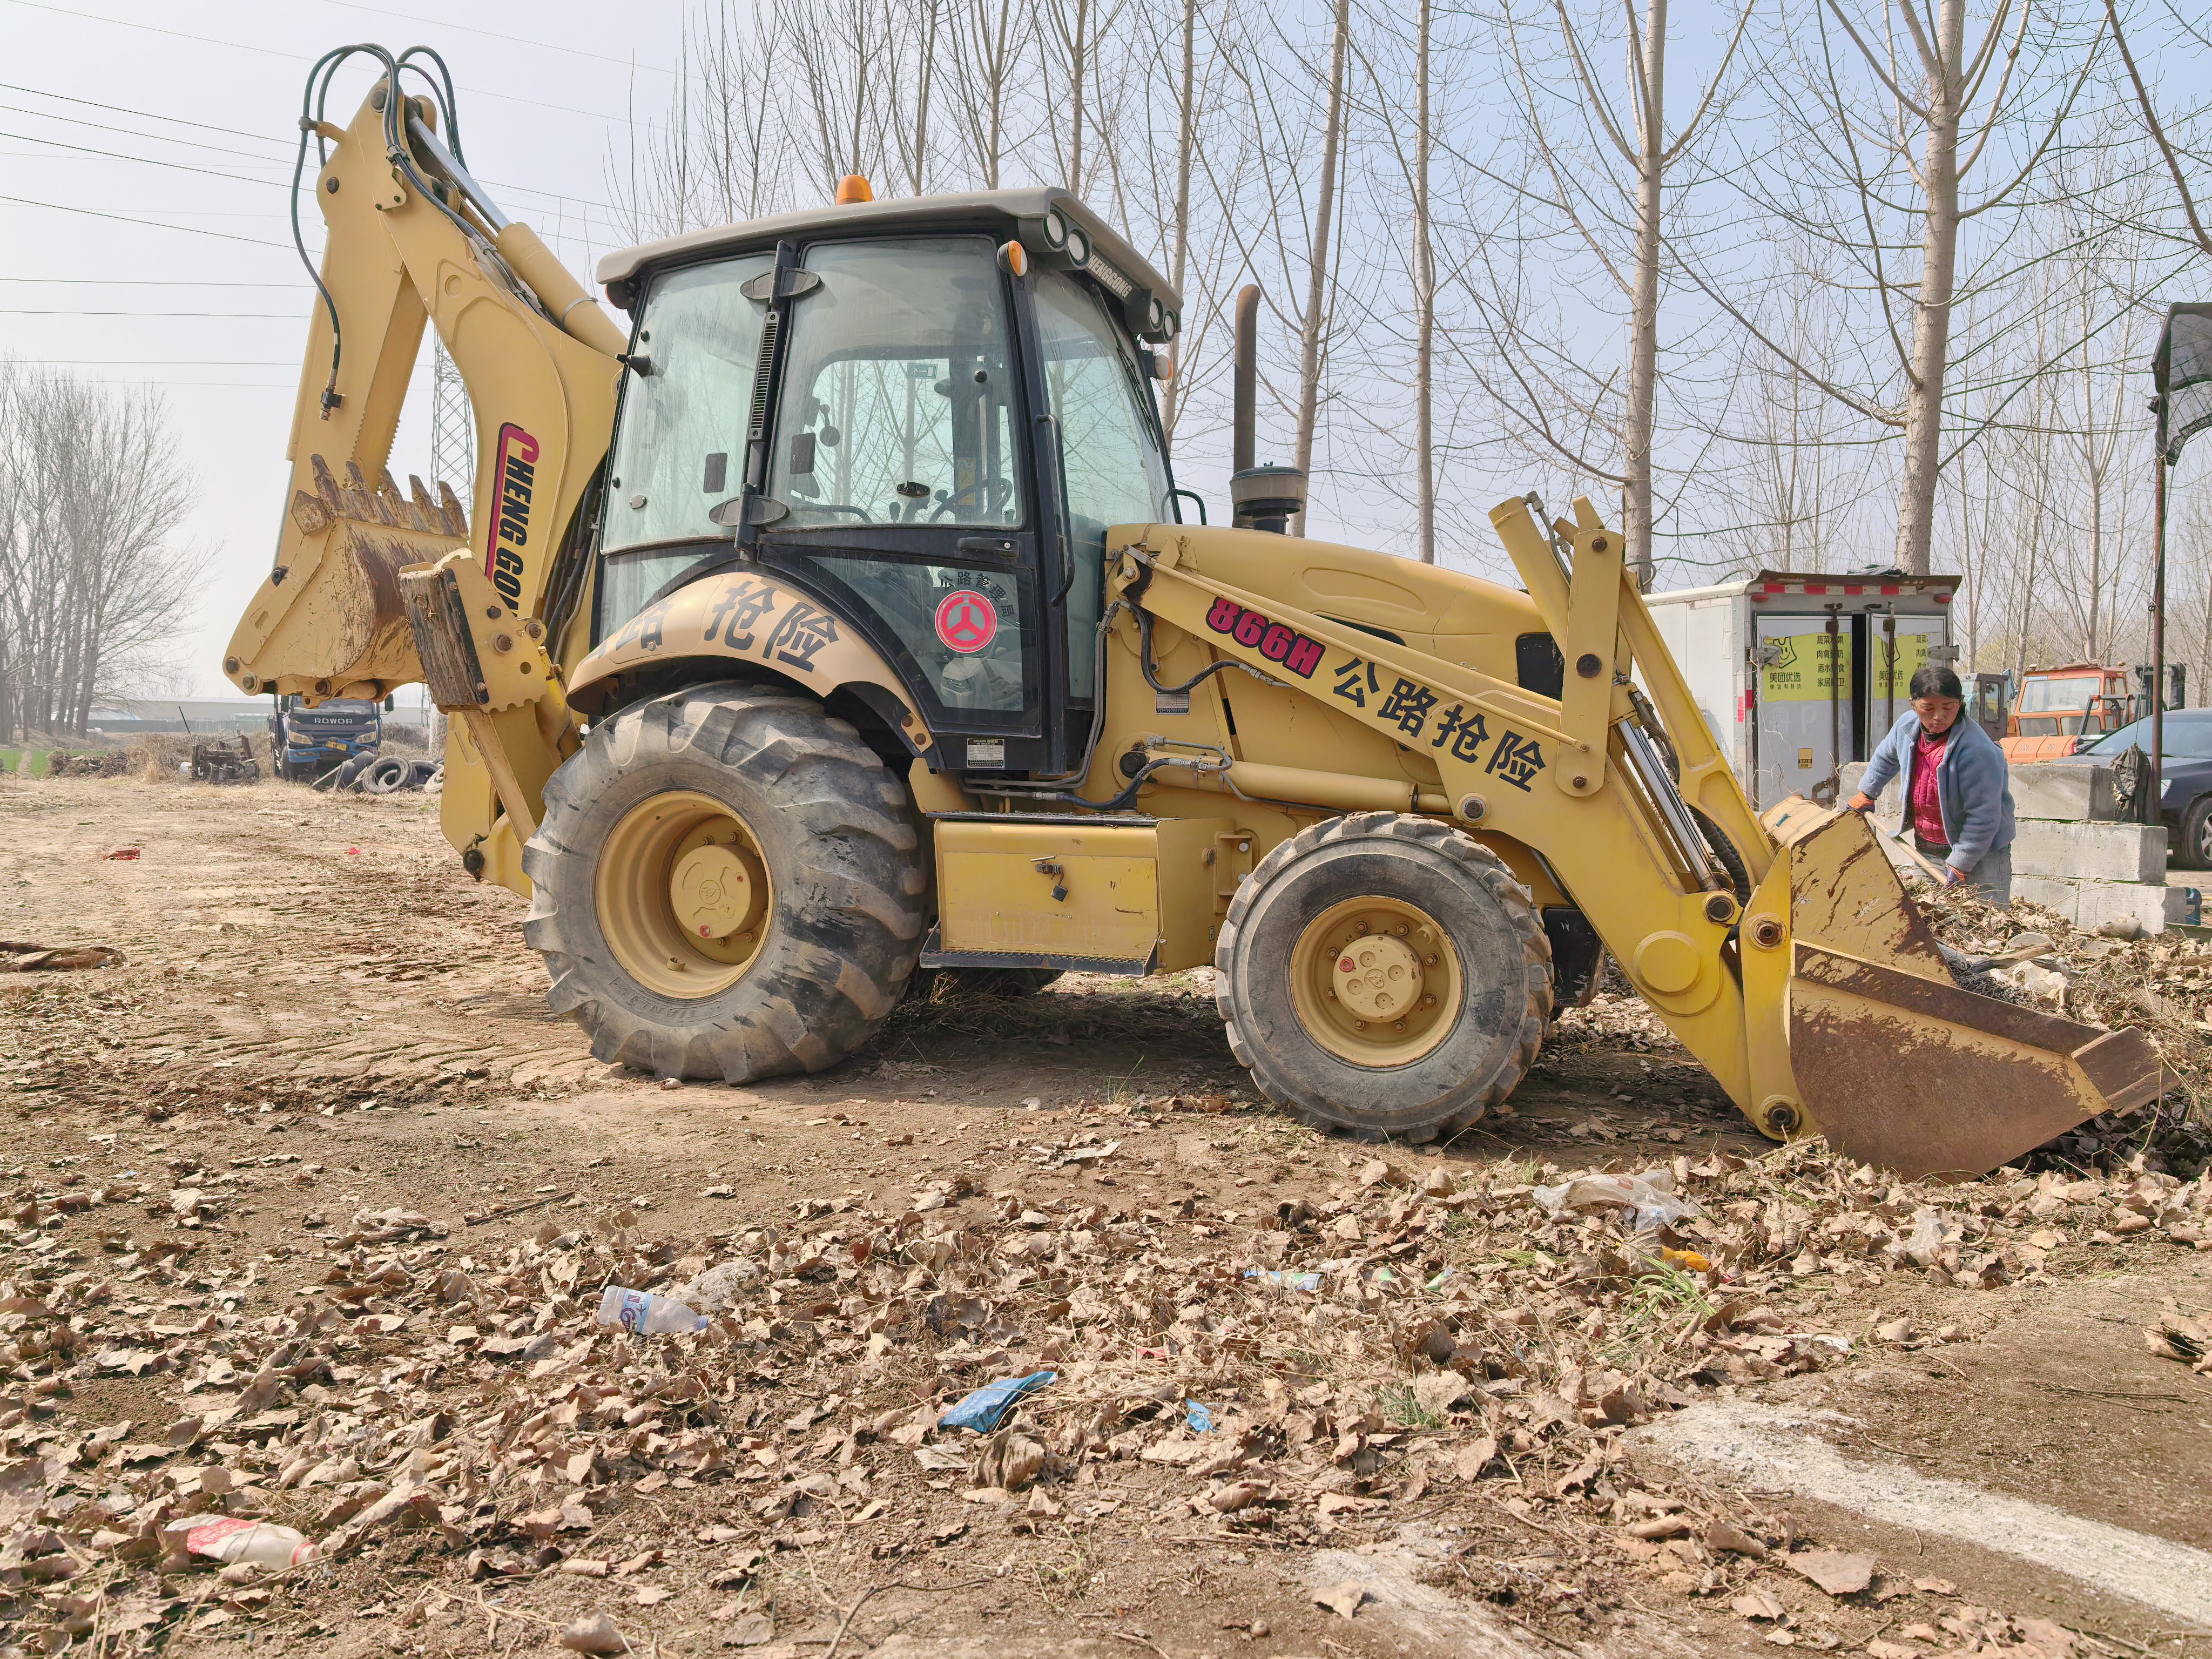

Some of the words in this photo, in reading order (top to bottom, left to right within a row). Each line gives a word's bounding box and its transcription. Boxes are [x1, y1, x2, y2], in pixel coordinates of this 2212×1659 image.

[1087, 252, 1132, 298] HENGGONG
[485, 422, 539, 546] CHENG
[1205, 596, 1326, 679] 866H
[1817, 635, 1844, 645] 蔬菜果
[1770, 672, 1801, 683] 美团优选
[1817, 663, 1844, 673] 酒水食
[1817, 678, 1844, 687] 家居卫
[1332, 657, 1547, 793] 公路抢险
